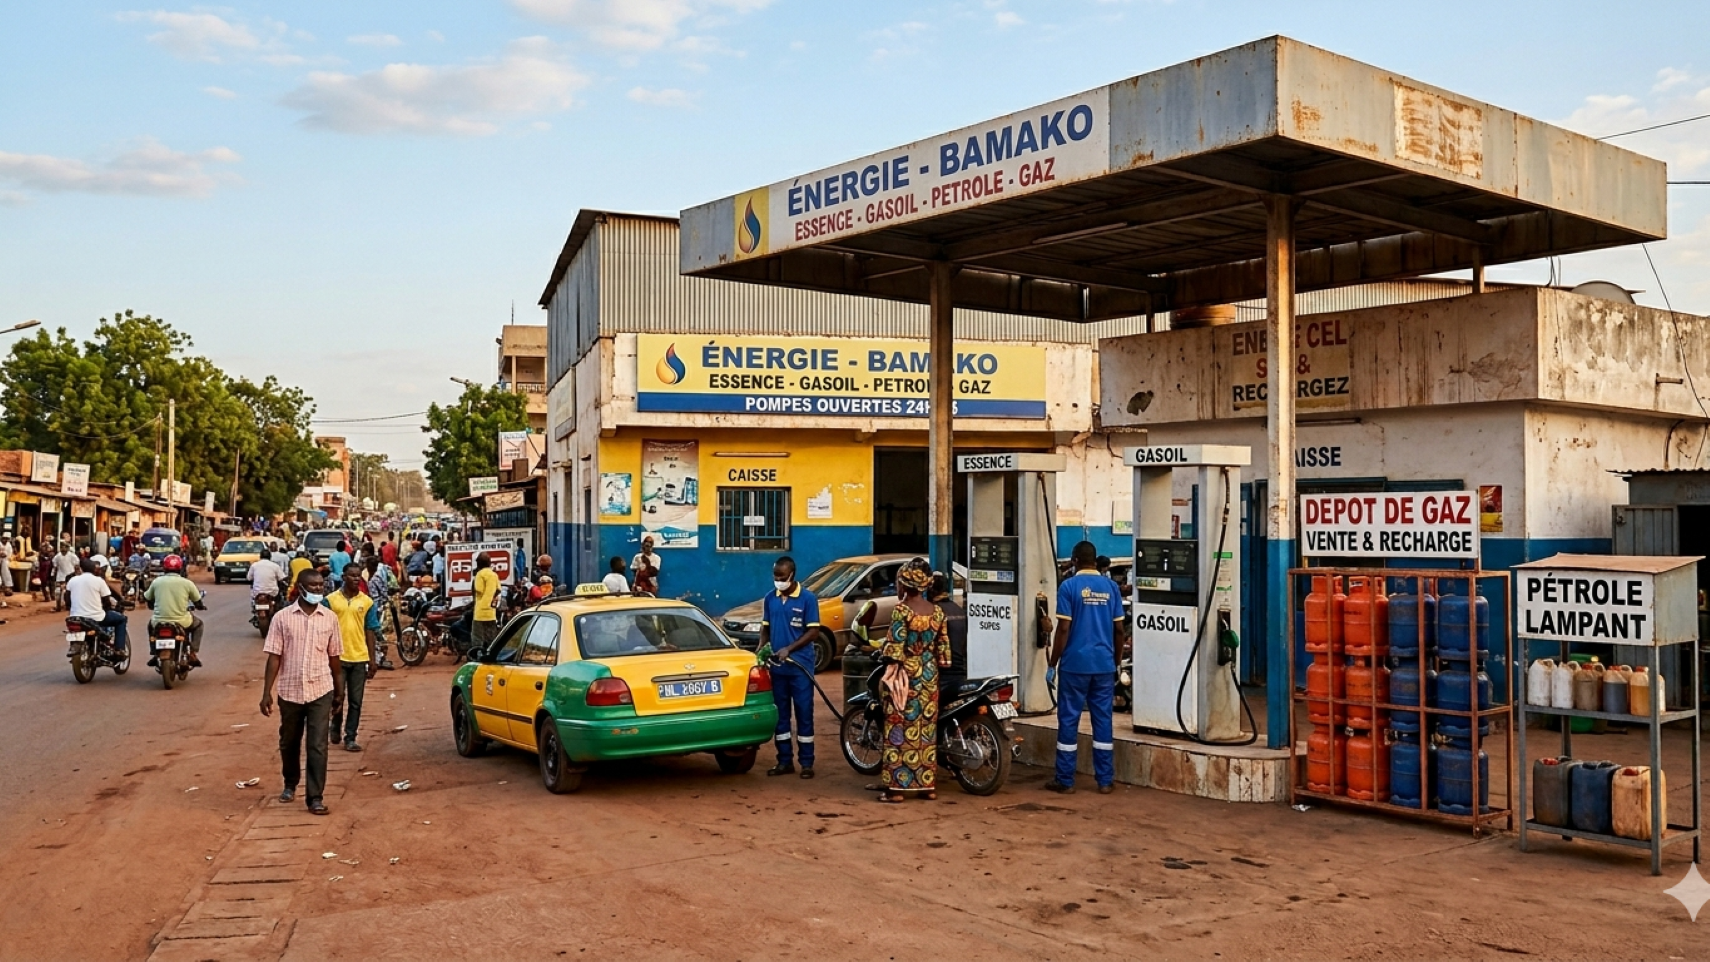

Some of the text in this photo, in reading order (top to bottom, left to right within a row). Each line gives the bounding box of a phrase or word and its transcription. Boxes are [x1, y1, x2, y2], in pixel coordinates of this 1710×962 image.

[788, 179, 909, 217] ÉNERGIE
[940, 104, 1093, 177] BAMAKO
[795, 208, 854, 241] ESSENCE
[865, 193, 918, 224] GASOIL
[931, 170, 1003, 208] PETROLE
[1019, 156, 1055, 187] GAZ
[1307, 319, 1347, 348] CEL
[702, 340, 839, 371] ÉNERGIE
[868, 350, 998, 375] BAMKO
[709, 373, 785, 390] ESSENCE
[799, 376, 860, 392] GASOIL
[959, 379, 992, 394] GAZ
[1232, 376, 1350, 402] RECRGEZ
[745, 397, 812, 412] POMPES
[817, 398, 902, 414] OUVERTES
[964, 455, 1012, 469] ESSENCE
[1135, 447, 1188, 463] GASOIL
[728, 468, 777, 482] CAISSE
[1306, 495, 1472, 525] DEPOT DE GAZ
[1306, 530, 1472, 552] VENTE & RECHARGE
[1527, 571, 1643, 606] PÉTROLE
[1136, 613, 1190, 633] GASOIL
[1525, 609, 1646, 639] LAMPANT
